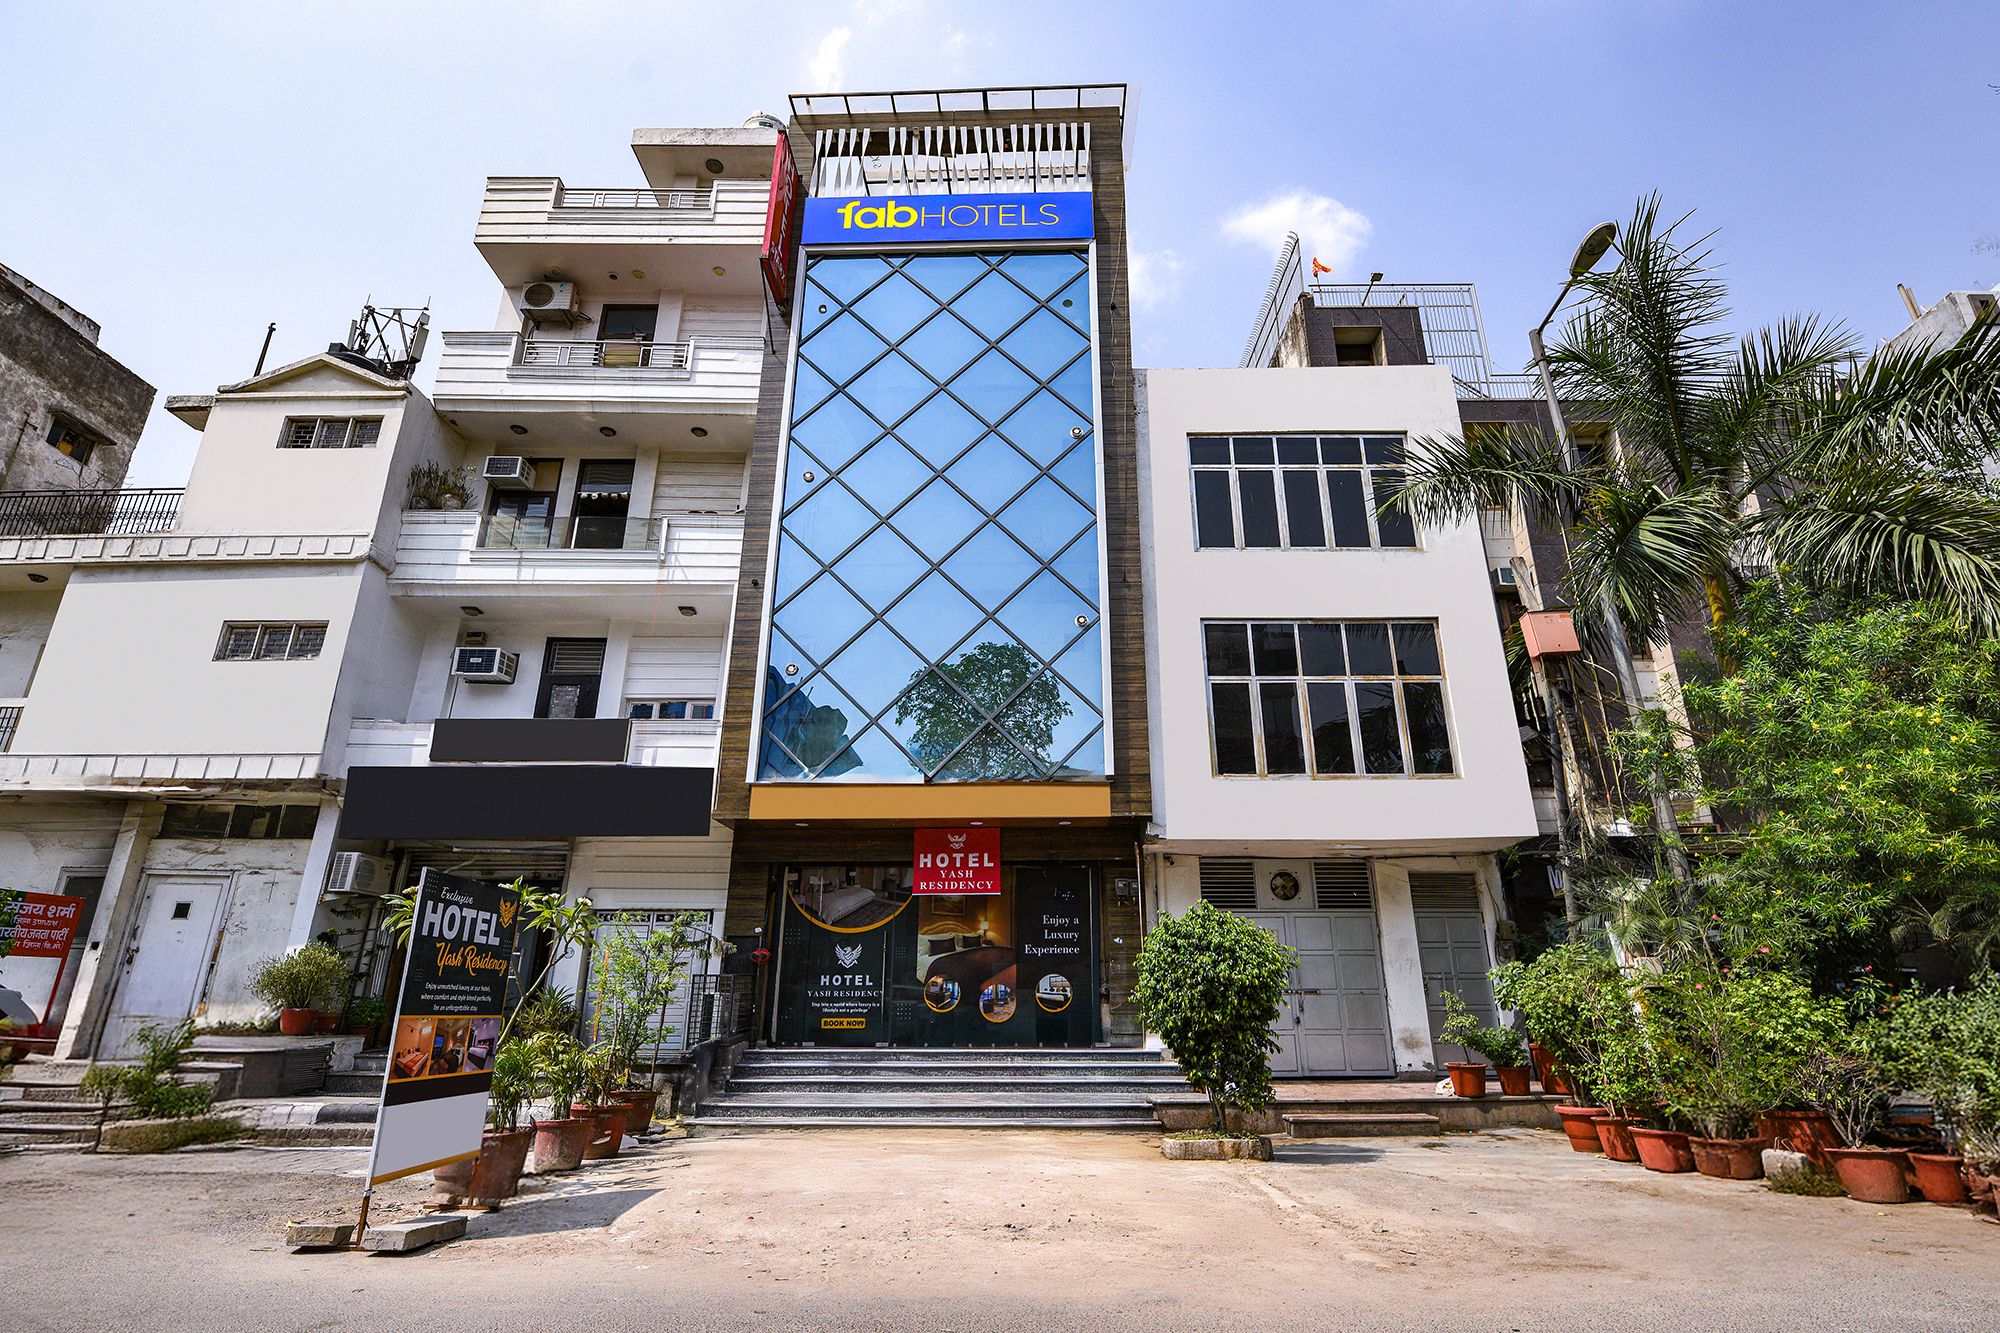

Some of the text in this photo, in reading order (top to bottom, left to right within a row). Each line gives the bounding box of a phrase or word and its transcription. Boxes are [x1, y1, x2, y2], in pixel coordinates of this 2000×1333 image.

[920, 853, 994, 868] HOTEL
[940, 870, 973, 878] YASH
[920, 881, 993, 890] RESIDENCY
[440, 887, 474, 905] Exclusive
[3, 897, 76, 918] संजय शर्मा
[421, 900, 500, 946] HOTEL
[1043, 914, 1070, 927] Enjoy
[0, 925, 70, 940] ारतीय जनता पार्टी
[1044, 929, 1079, 941] Luxury
[1024, 944, 1080, 956] Experience
[436, 942, 507, 977] Yash Residency
[820, 975, 873, 986] HOTEL
